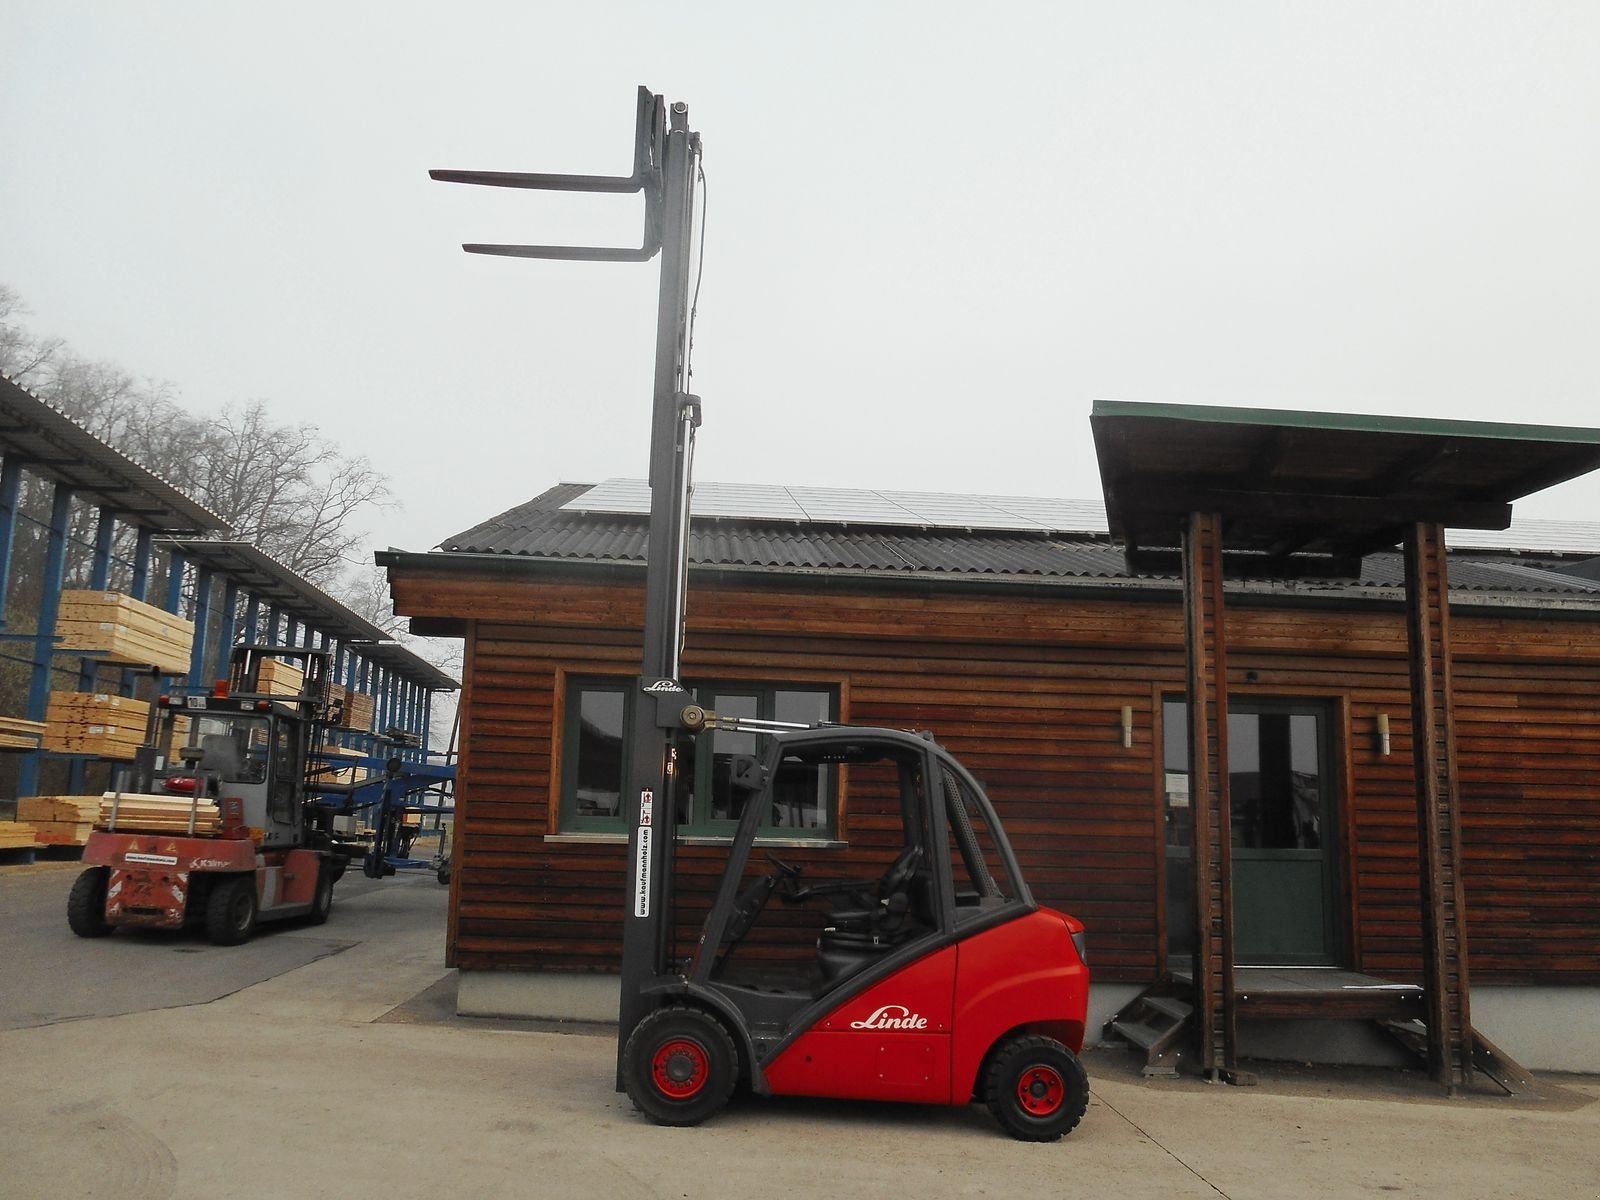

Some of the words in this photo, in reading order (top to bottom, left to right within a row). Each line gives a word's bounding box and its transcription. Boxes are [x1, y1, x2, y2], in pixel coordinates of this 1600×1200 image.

[643, 680, 684, 692] Linde
[640, 829, 649, 915] www.kaufmannholz.com
[850, 1005, 928, 1029] Linde
